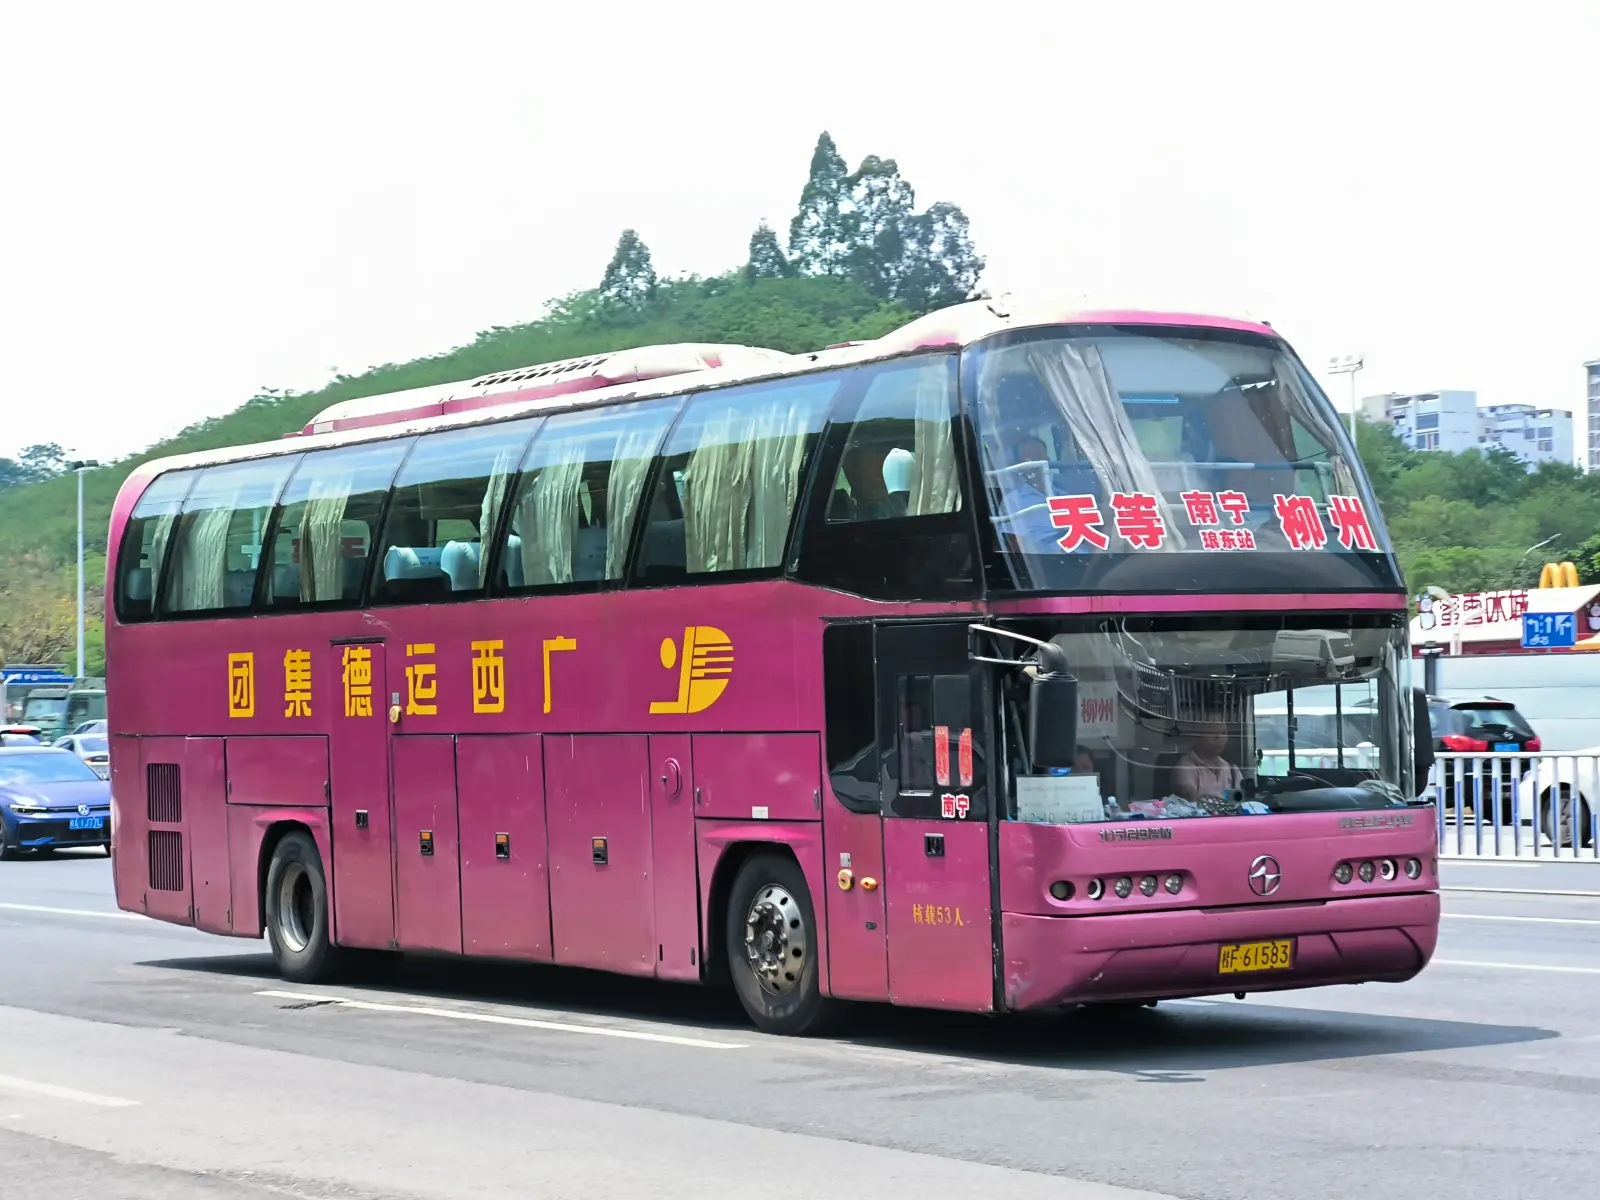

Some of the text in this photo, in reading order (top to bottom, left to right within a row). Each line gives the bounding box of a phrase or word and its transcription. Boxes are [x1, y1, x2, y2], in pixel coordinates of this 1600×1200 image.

[1048, 491, 1381, 552] 天等 南宁 柳州
[1201, 530, 1256, 551] 琅东站
[1081, 698, 1114, 724] 柳州
[941, 795, 970, 818] 南宁
[913, 904, 964, 927] 核载53人
